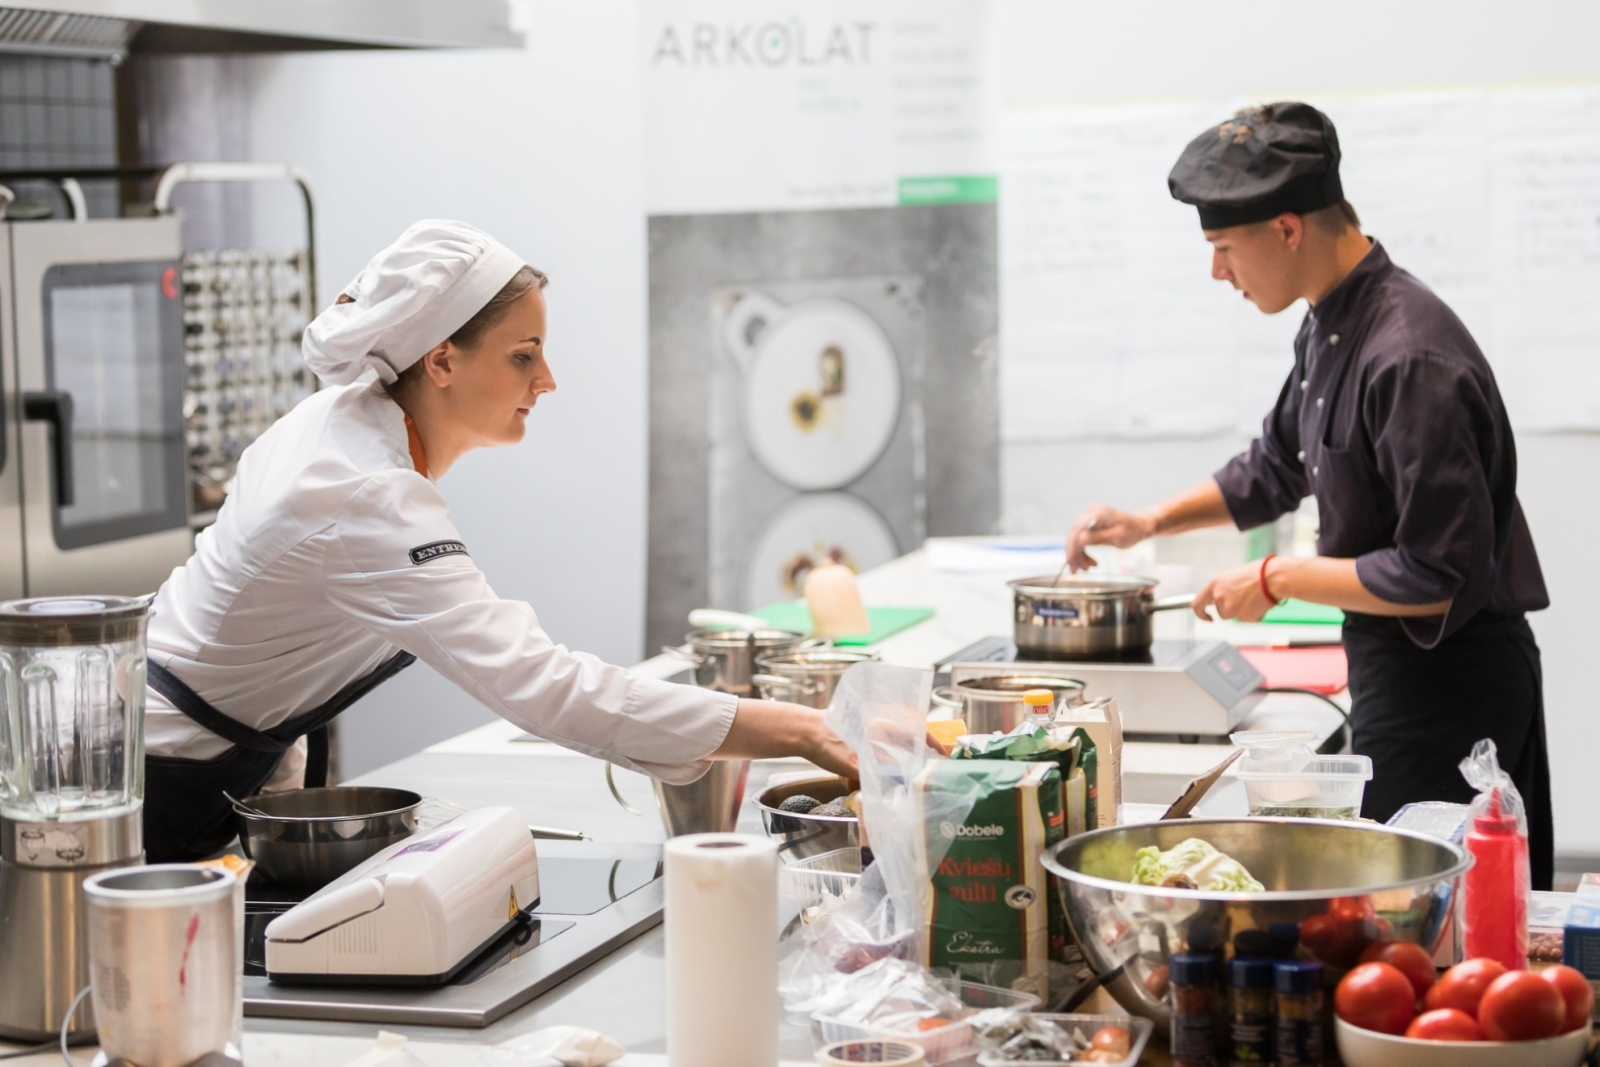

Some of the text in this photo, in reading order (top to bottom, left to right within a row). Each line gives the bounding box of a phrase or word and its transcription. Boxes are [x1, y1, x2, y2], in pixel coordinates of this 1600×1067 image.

[957, 824, 1004, 837] Dobele
[948, 882, 998, 902] milti
[946, 931, 1005, 955] Ekstra
